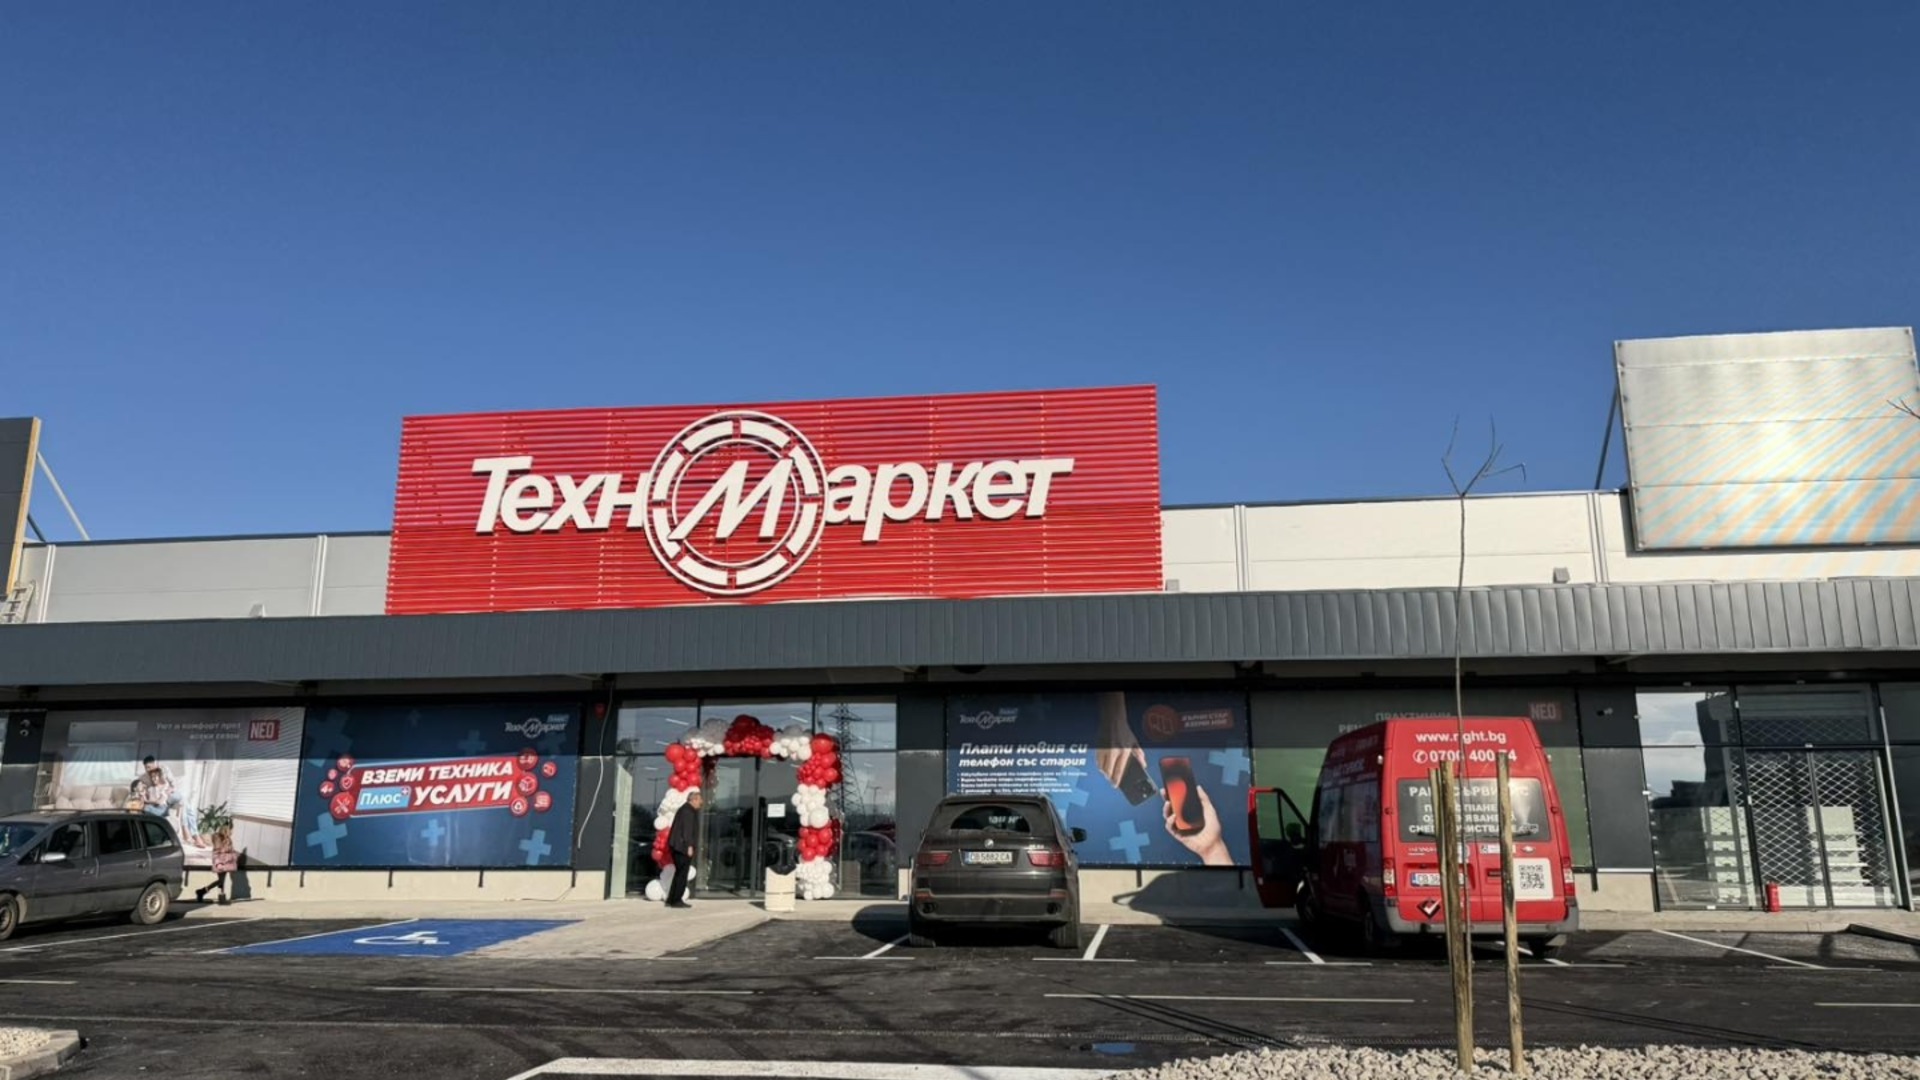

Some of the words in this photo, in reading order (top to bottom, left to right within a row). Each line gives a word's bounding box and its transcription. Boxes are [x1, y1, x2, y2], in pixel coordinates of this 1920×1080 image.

[1530, 703, 1556, 720] NEO
[250, 722, 276, 739] NEO
[1416, 731, 1506, 744] www.rght.bg
[960, 743, 1013, 755] Плати
[1017, 741, 1065, 754] новия
[1069, 744, 1088, 754] си
[1469, 749, 1495, 762] 400
[959, 757, 1014, 768] телефон
[1017, 758, 1037, 766] със
[1039, 758, 1086, 767] стария
[361, 766, 423, 785] ВЗЕМИ
[428, 761, 514, 780] ТЕХНИКА
[413, 781, 514, 806] УСЛУГИ
